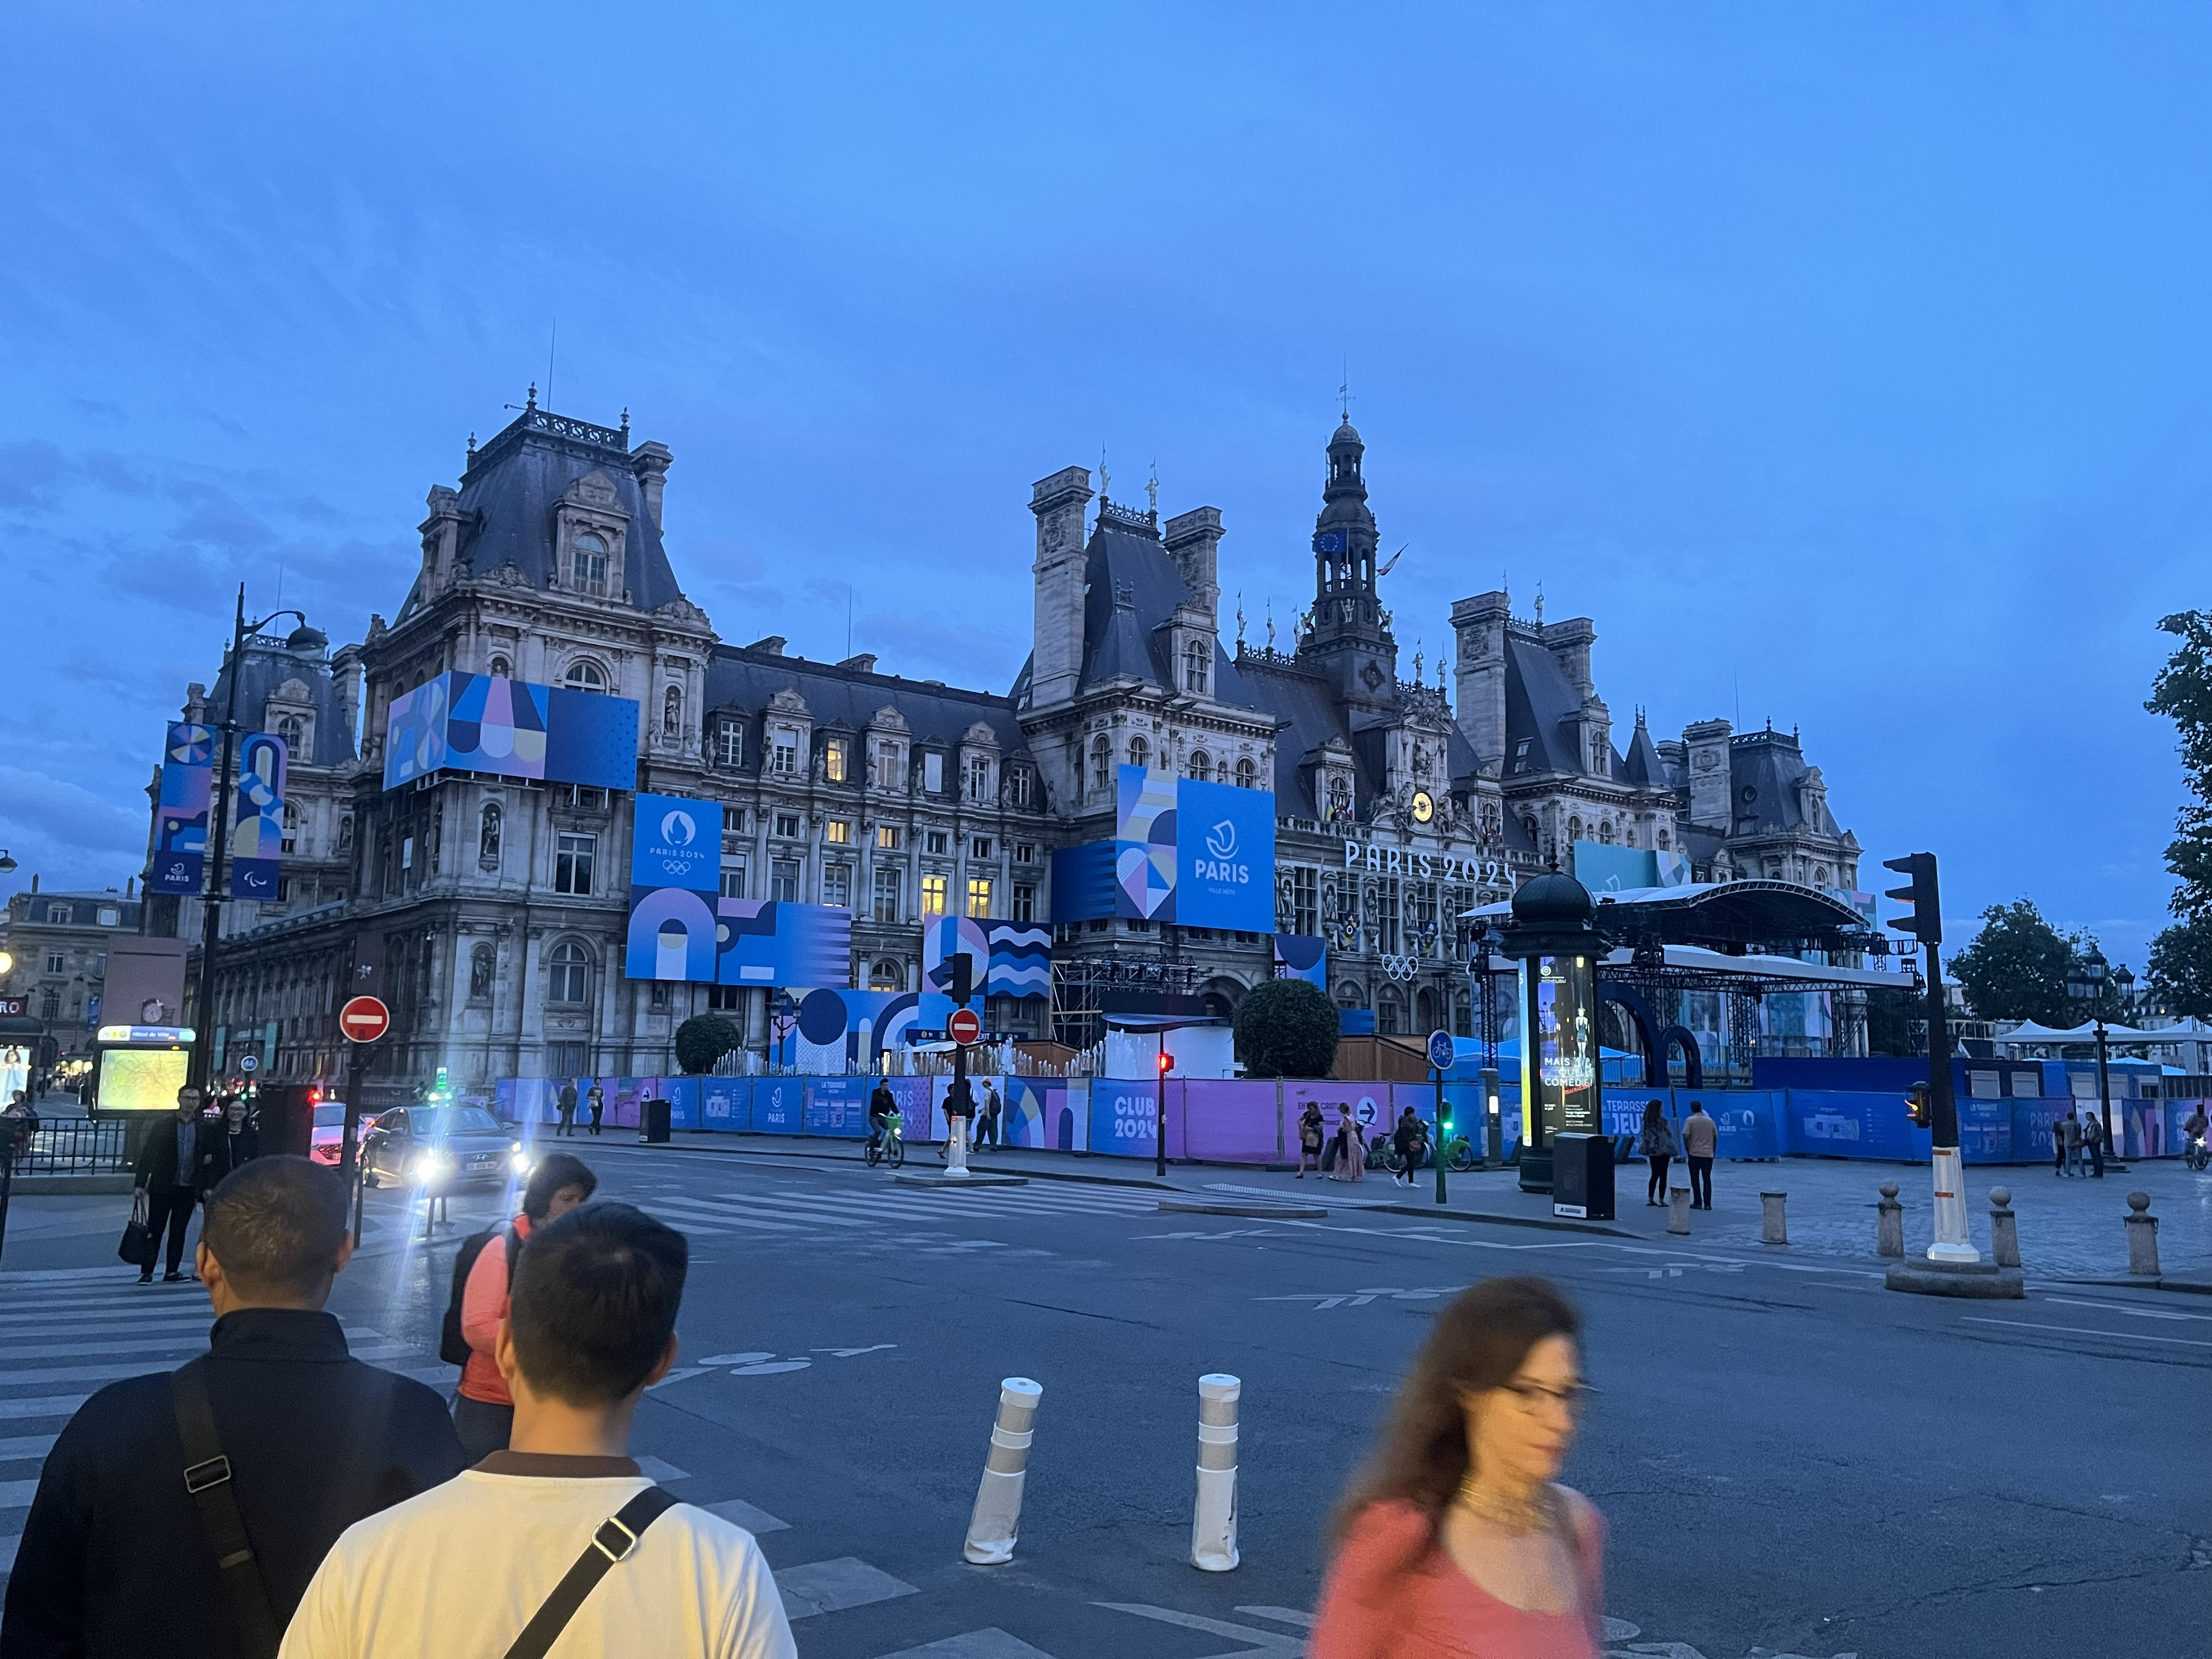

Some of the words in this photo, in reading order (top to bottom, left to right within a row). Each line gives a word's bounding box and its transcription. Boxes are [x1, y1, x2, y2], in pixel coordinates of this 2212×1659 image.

[680, 850, 704, 859] 2024
[165, 874, 189, 882] PARIS
[1195, 859, 1249, 884] PARIS
[1443, 855, 1517, 890] 2024
[1544, 1057, 1570, 1066] MAIS
[1114, 1096, 1156, 1116] CLUB
[768, 1113, 785, 1123] PARIS
[1612, 1113, 1644, 1135] JEU
[1114, 1118, 1157, 1139] 2024
